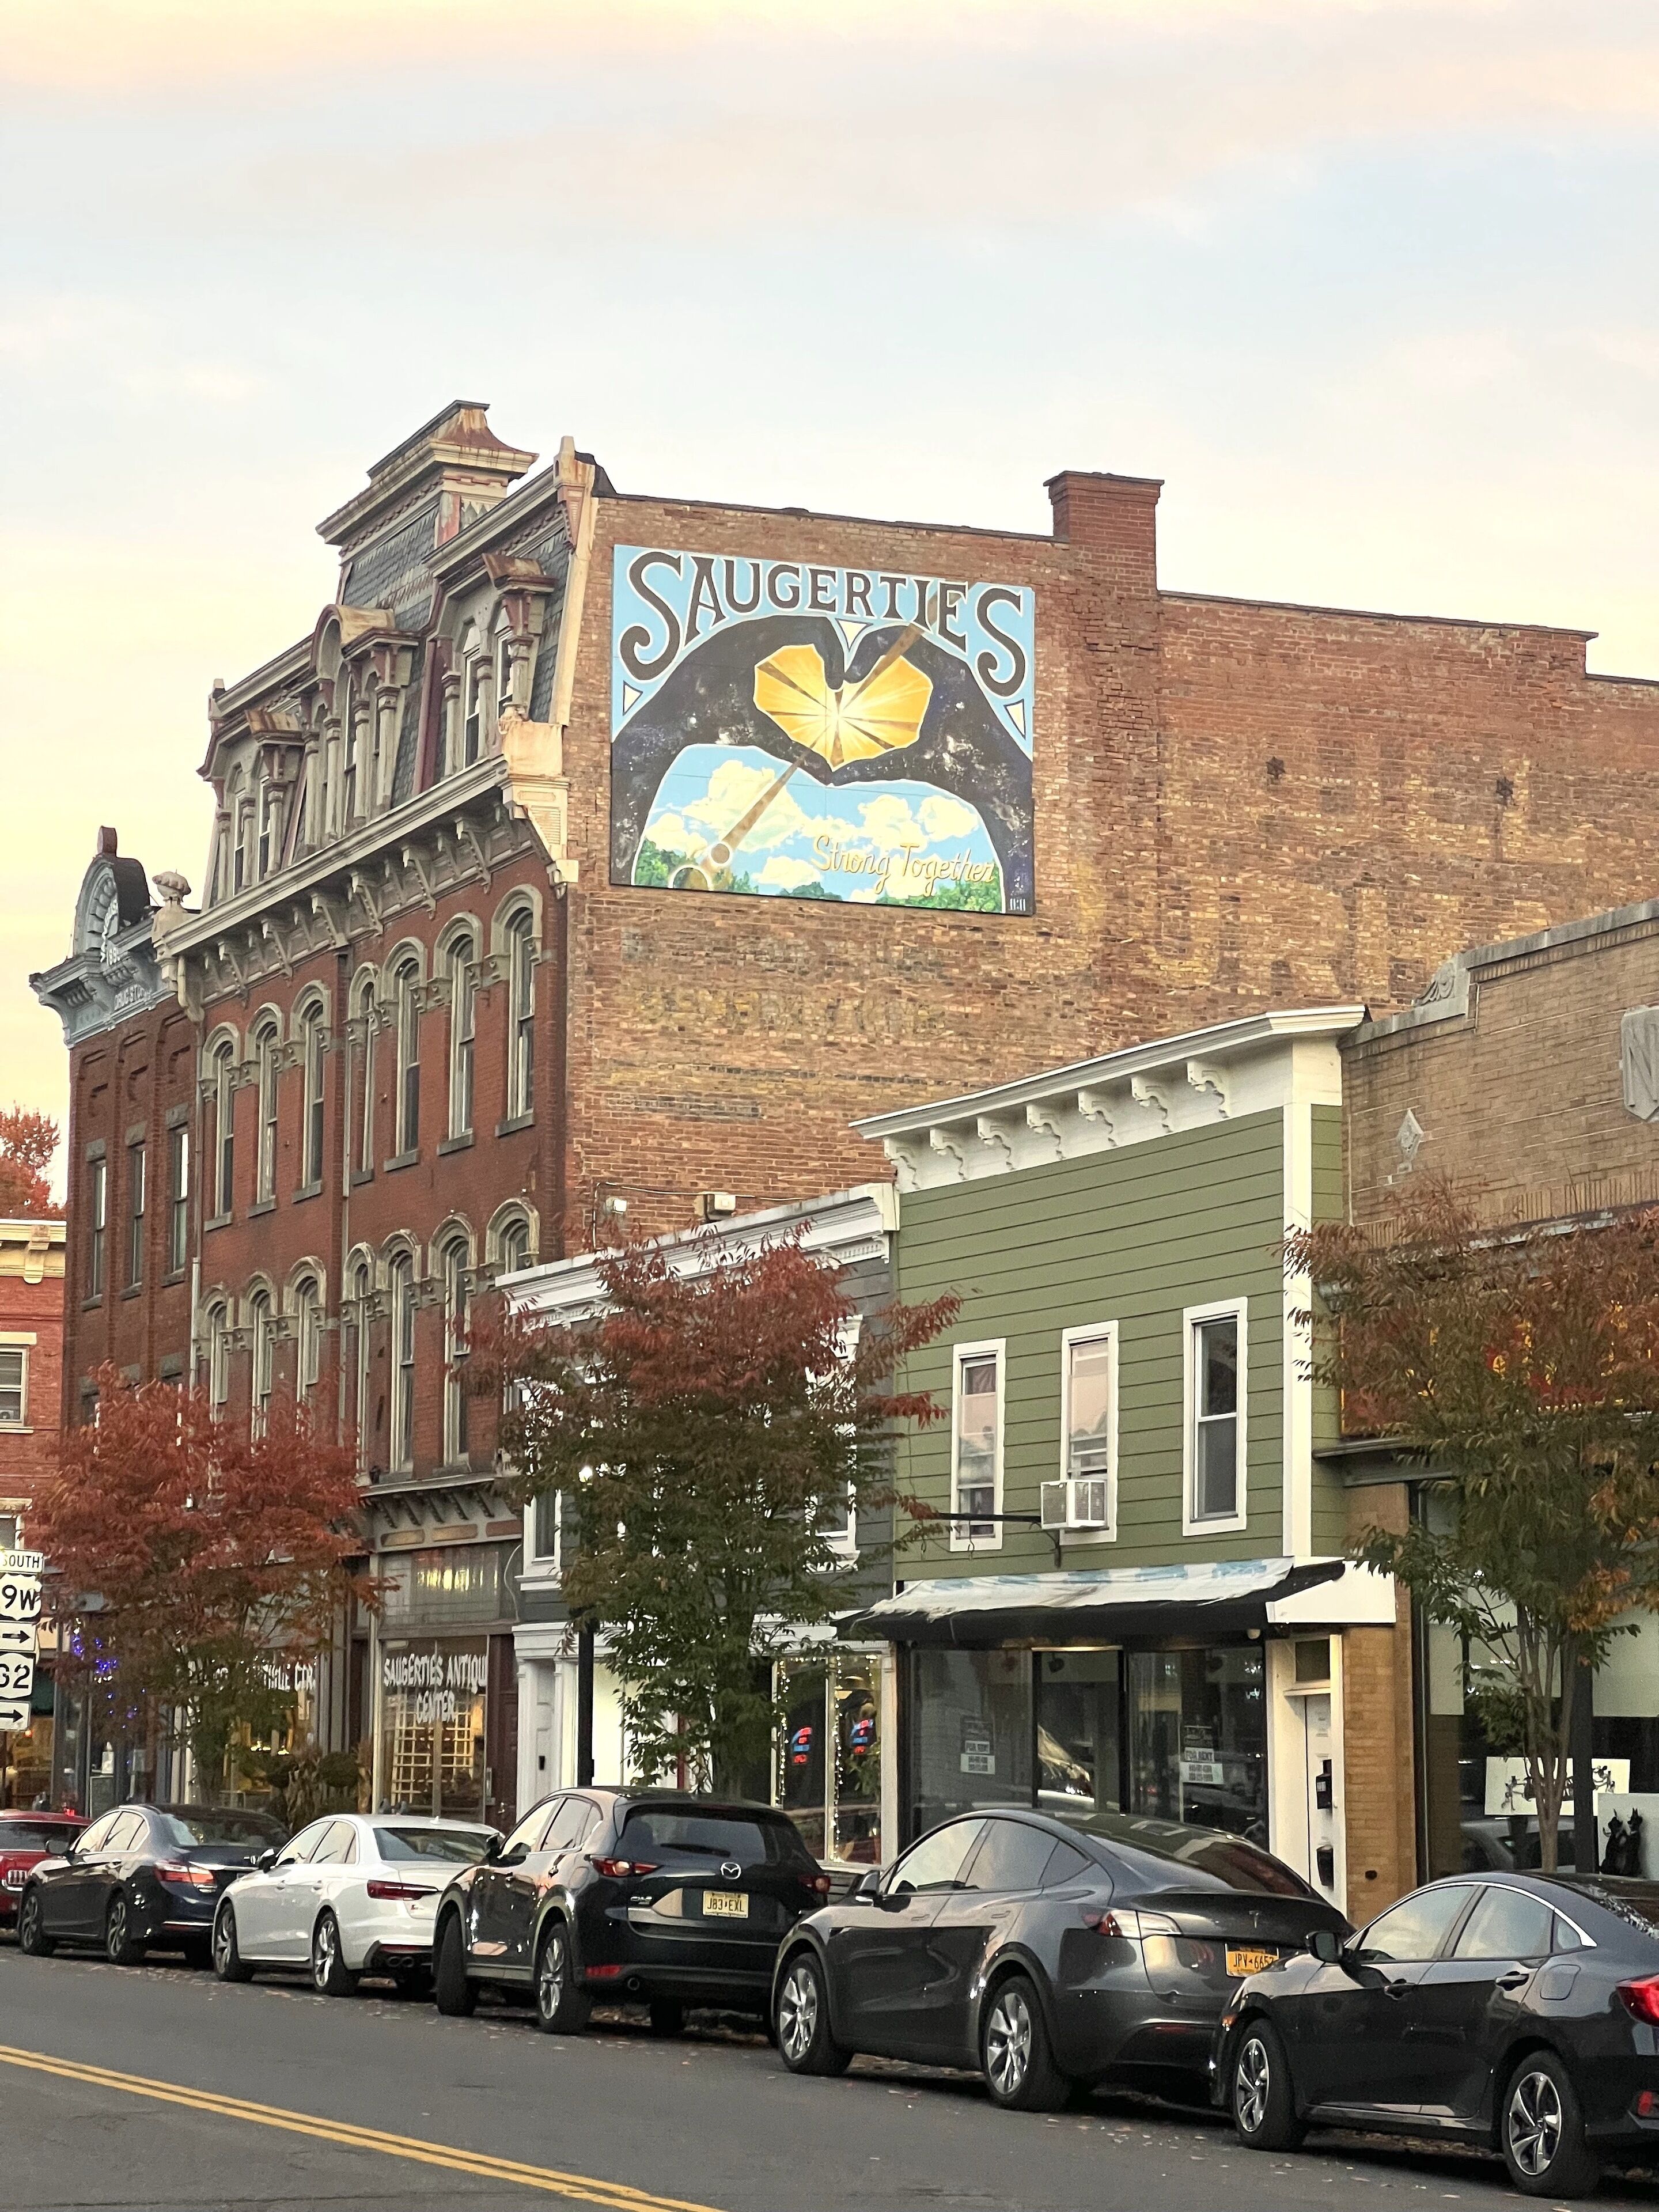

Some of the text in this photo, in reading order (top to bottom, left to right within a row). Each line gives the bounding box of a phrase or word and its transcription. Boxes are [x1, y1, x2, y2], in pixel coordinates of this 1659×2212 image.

[619, 551, 1025, 696] SAUGERTIES
[811, 835, 995, 897] Strong Together
[2, 1584, 35, 1610] 9W
[0, 1663, 29, 1689] 32
[384, 1653, 444, 1687] SAUGERTIES
[416, 1690, 455, 1724] CENTER
